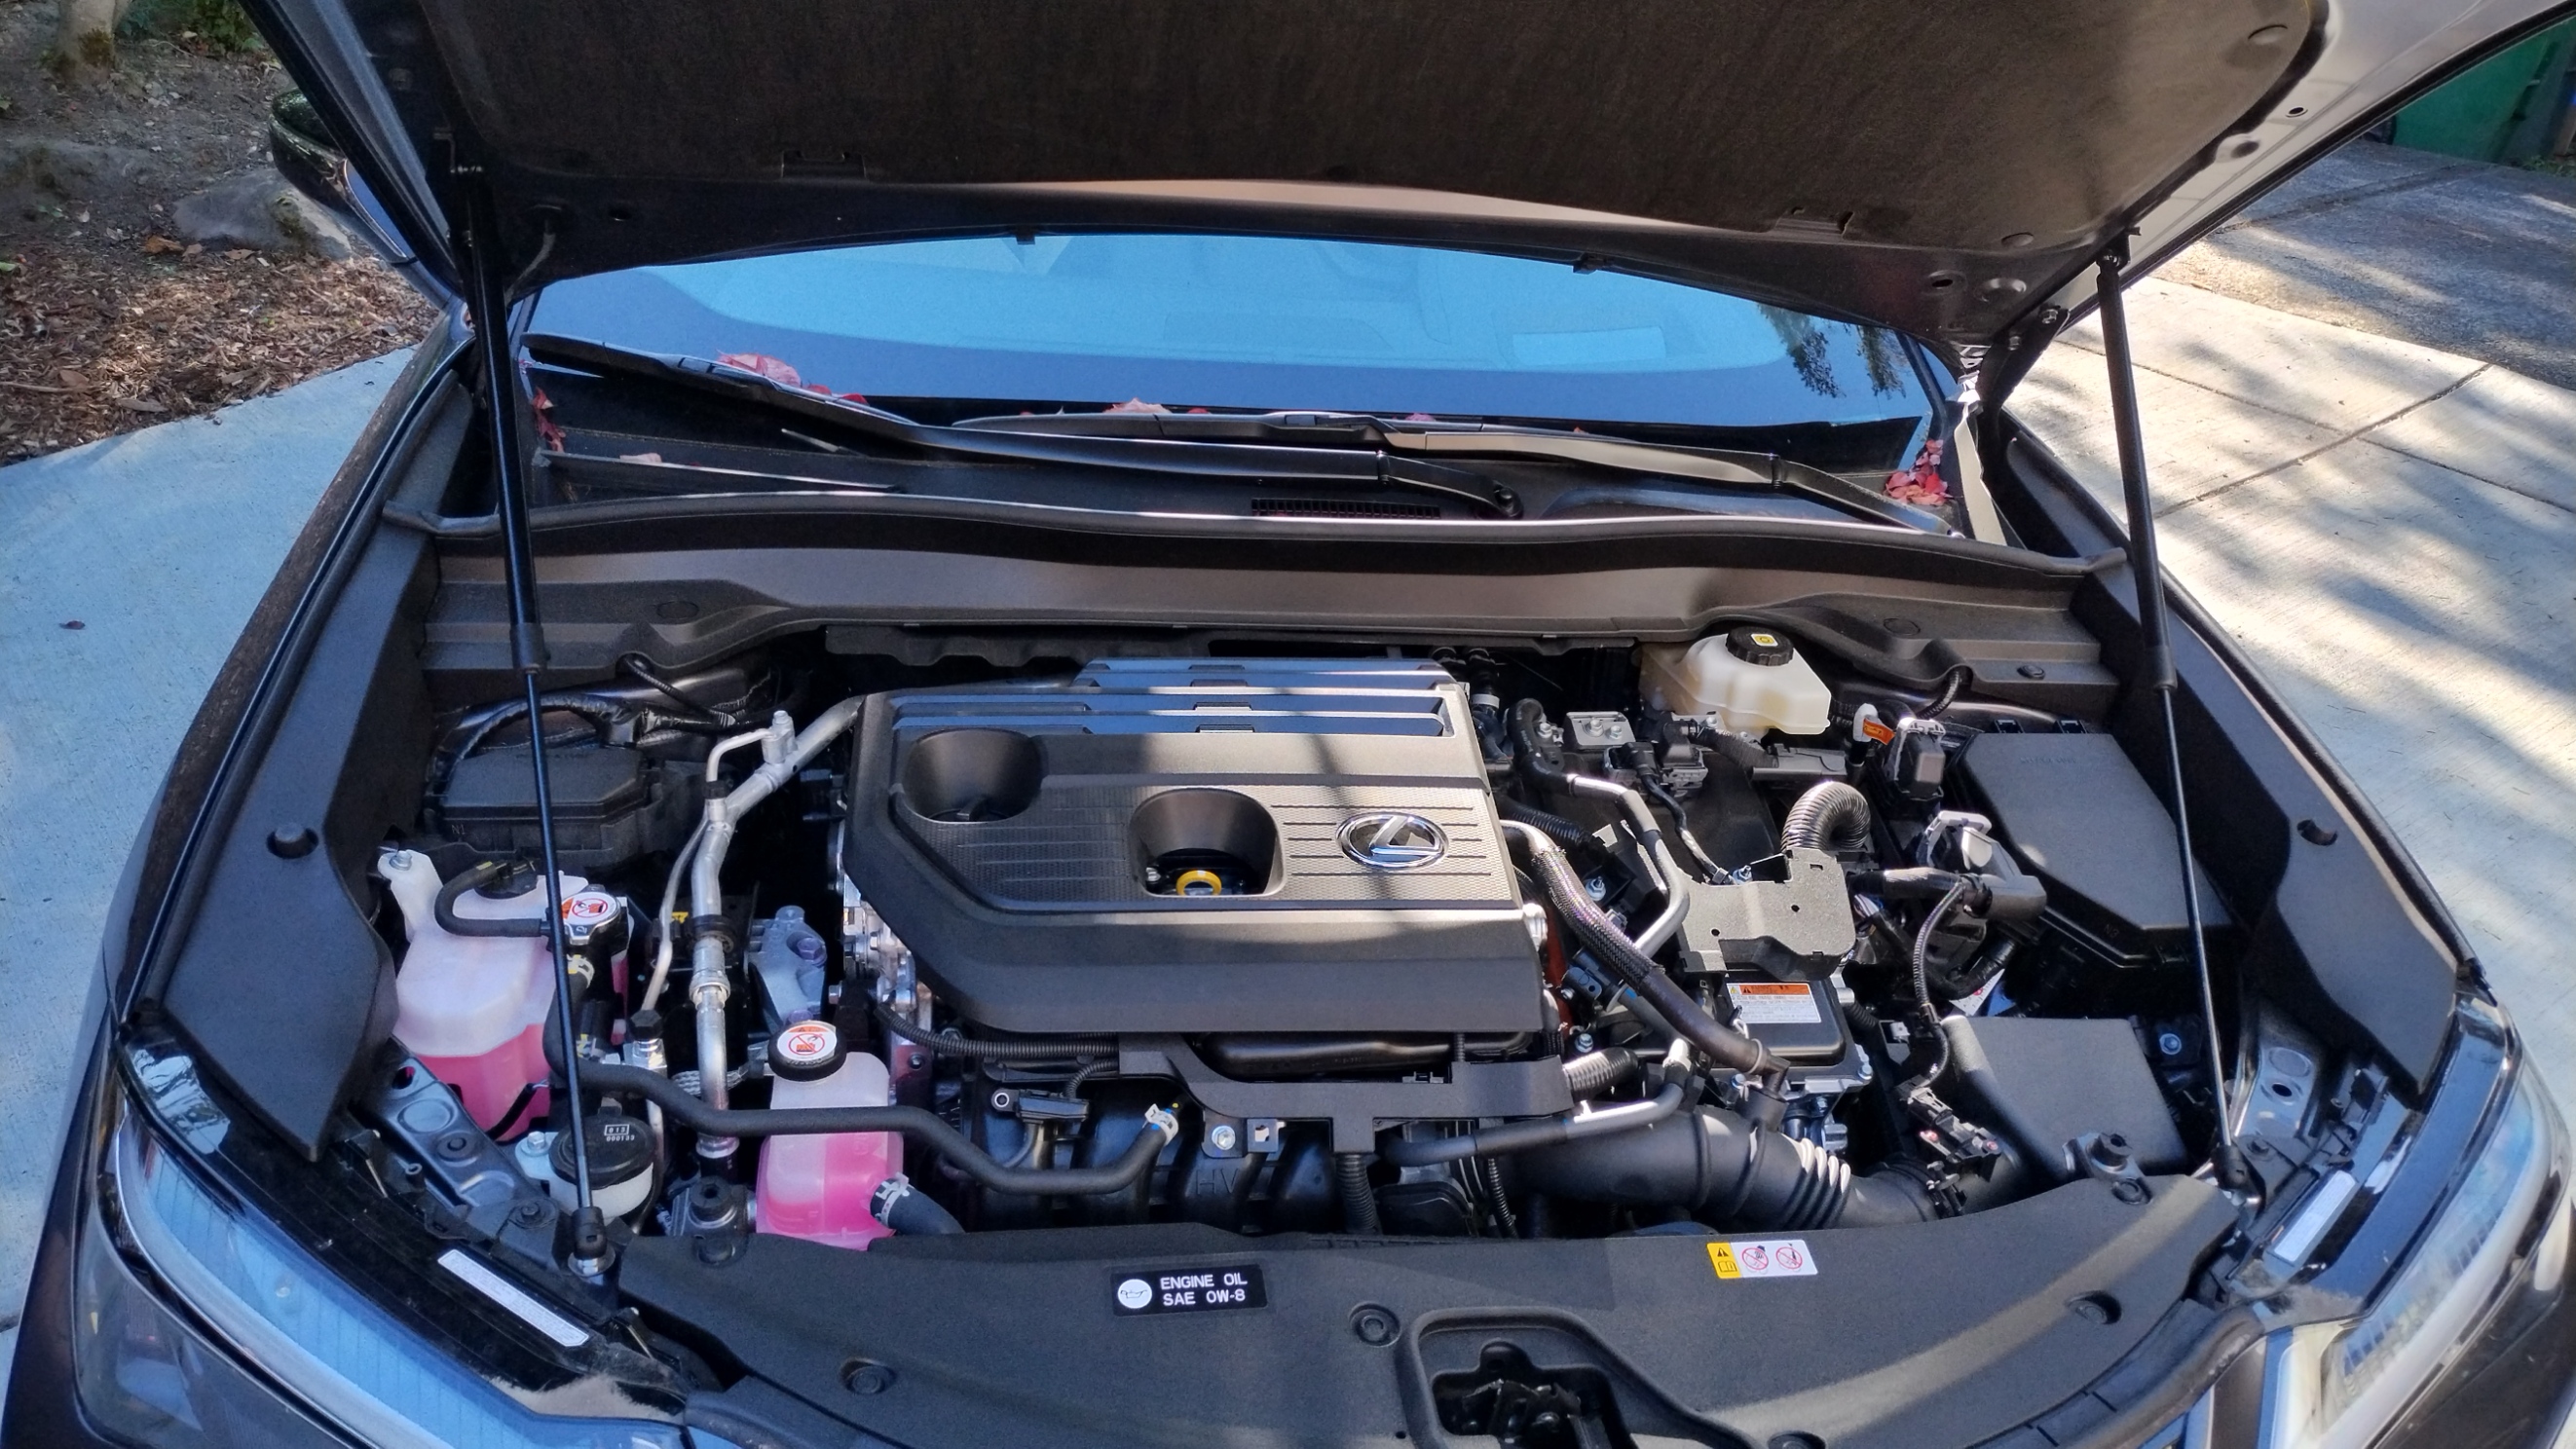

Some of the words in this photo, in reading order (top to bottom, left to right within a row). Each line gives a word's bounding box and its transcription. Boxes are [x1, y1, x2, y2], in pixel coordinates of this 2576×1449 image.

[1195, 1168, 1240, 1196] HV
[1160, 1274, 1214, 1290] ENGINE
[1223, 1272, 1248, 1286] OIL
[1163, 1291, 1196, 1306] SAE
